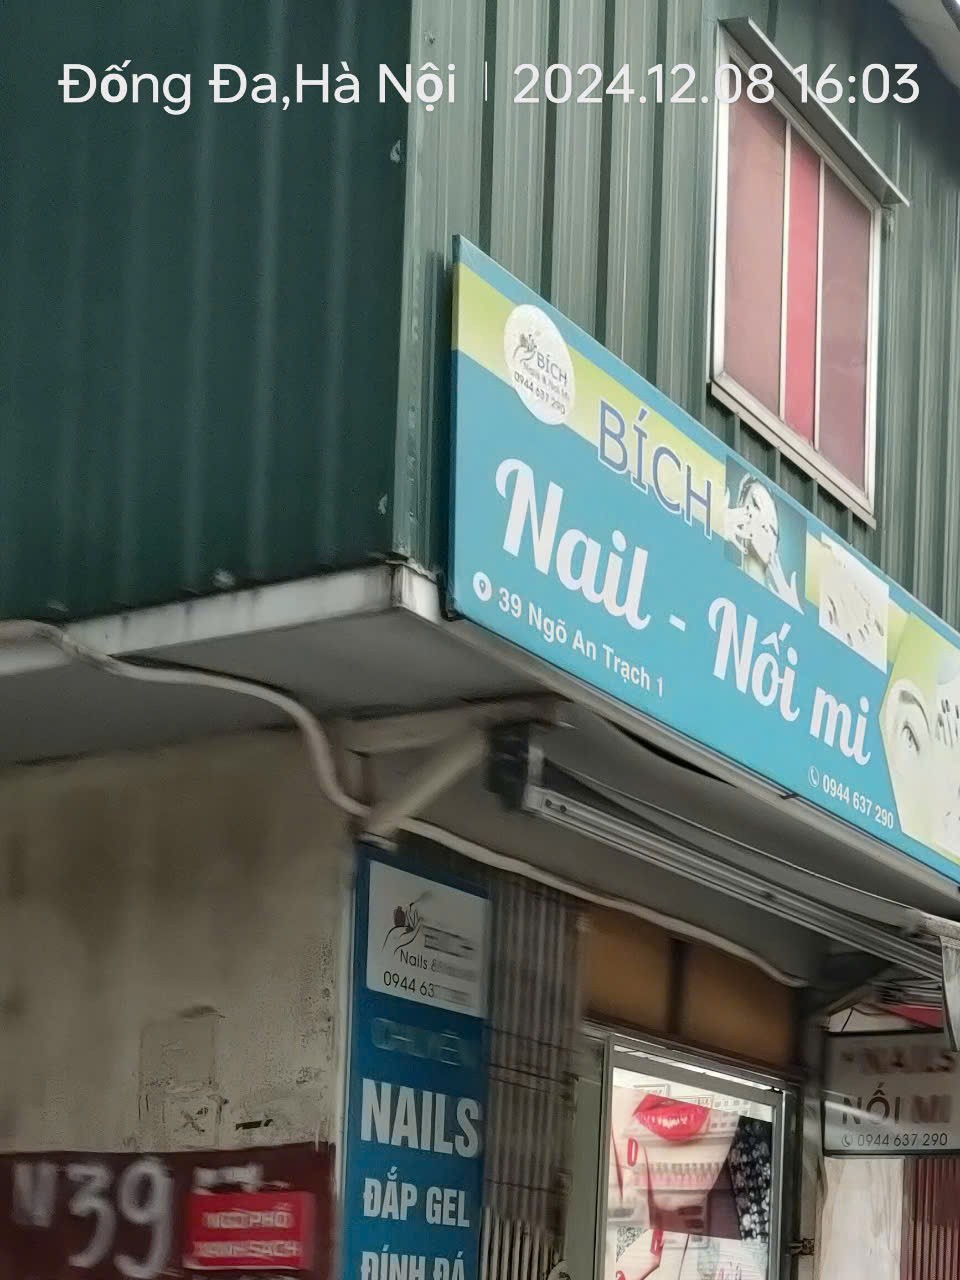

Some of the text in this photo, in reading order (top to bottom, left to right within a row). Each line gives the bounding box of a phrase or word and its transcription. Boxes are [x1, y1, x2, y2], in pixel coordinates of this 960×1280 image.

[598, 397, 713, 540] BÍCH
[495, 458, 651, 630] Nail
[708, 597, 800, 722] Nối
[809, 686, 871, 765] mi
[498, 587, 522, 618] 39
[528, 602, 567, 643] Ngõ
[572, 629, 597, 661] An
[602, 644, 651, 691] Trạch
[823, 774, 894, 829] 0944 637 290
[383, 970, 416, 993] 0944
[400, 949, 428, 970] Nails
[360, 1078, 482, 1158] NAILS
[857, 1132, 948, 1147] 0944 637 290
[363, 1166, 470, 1228] ĐẮP GEL
